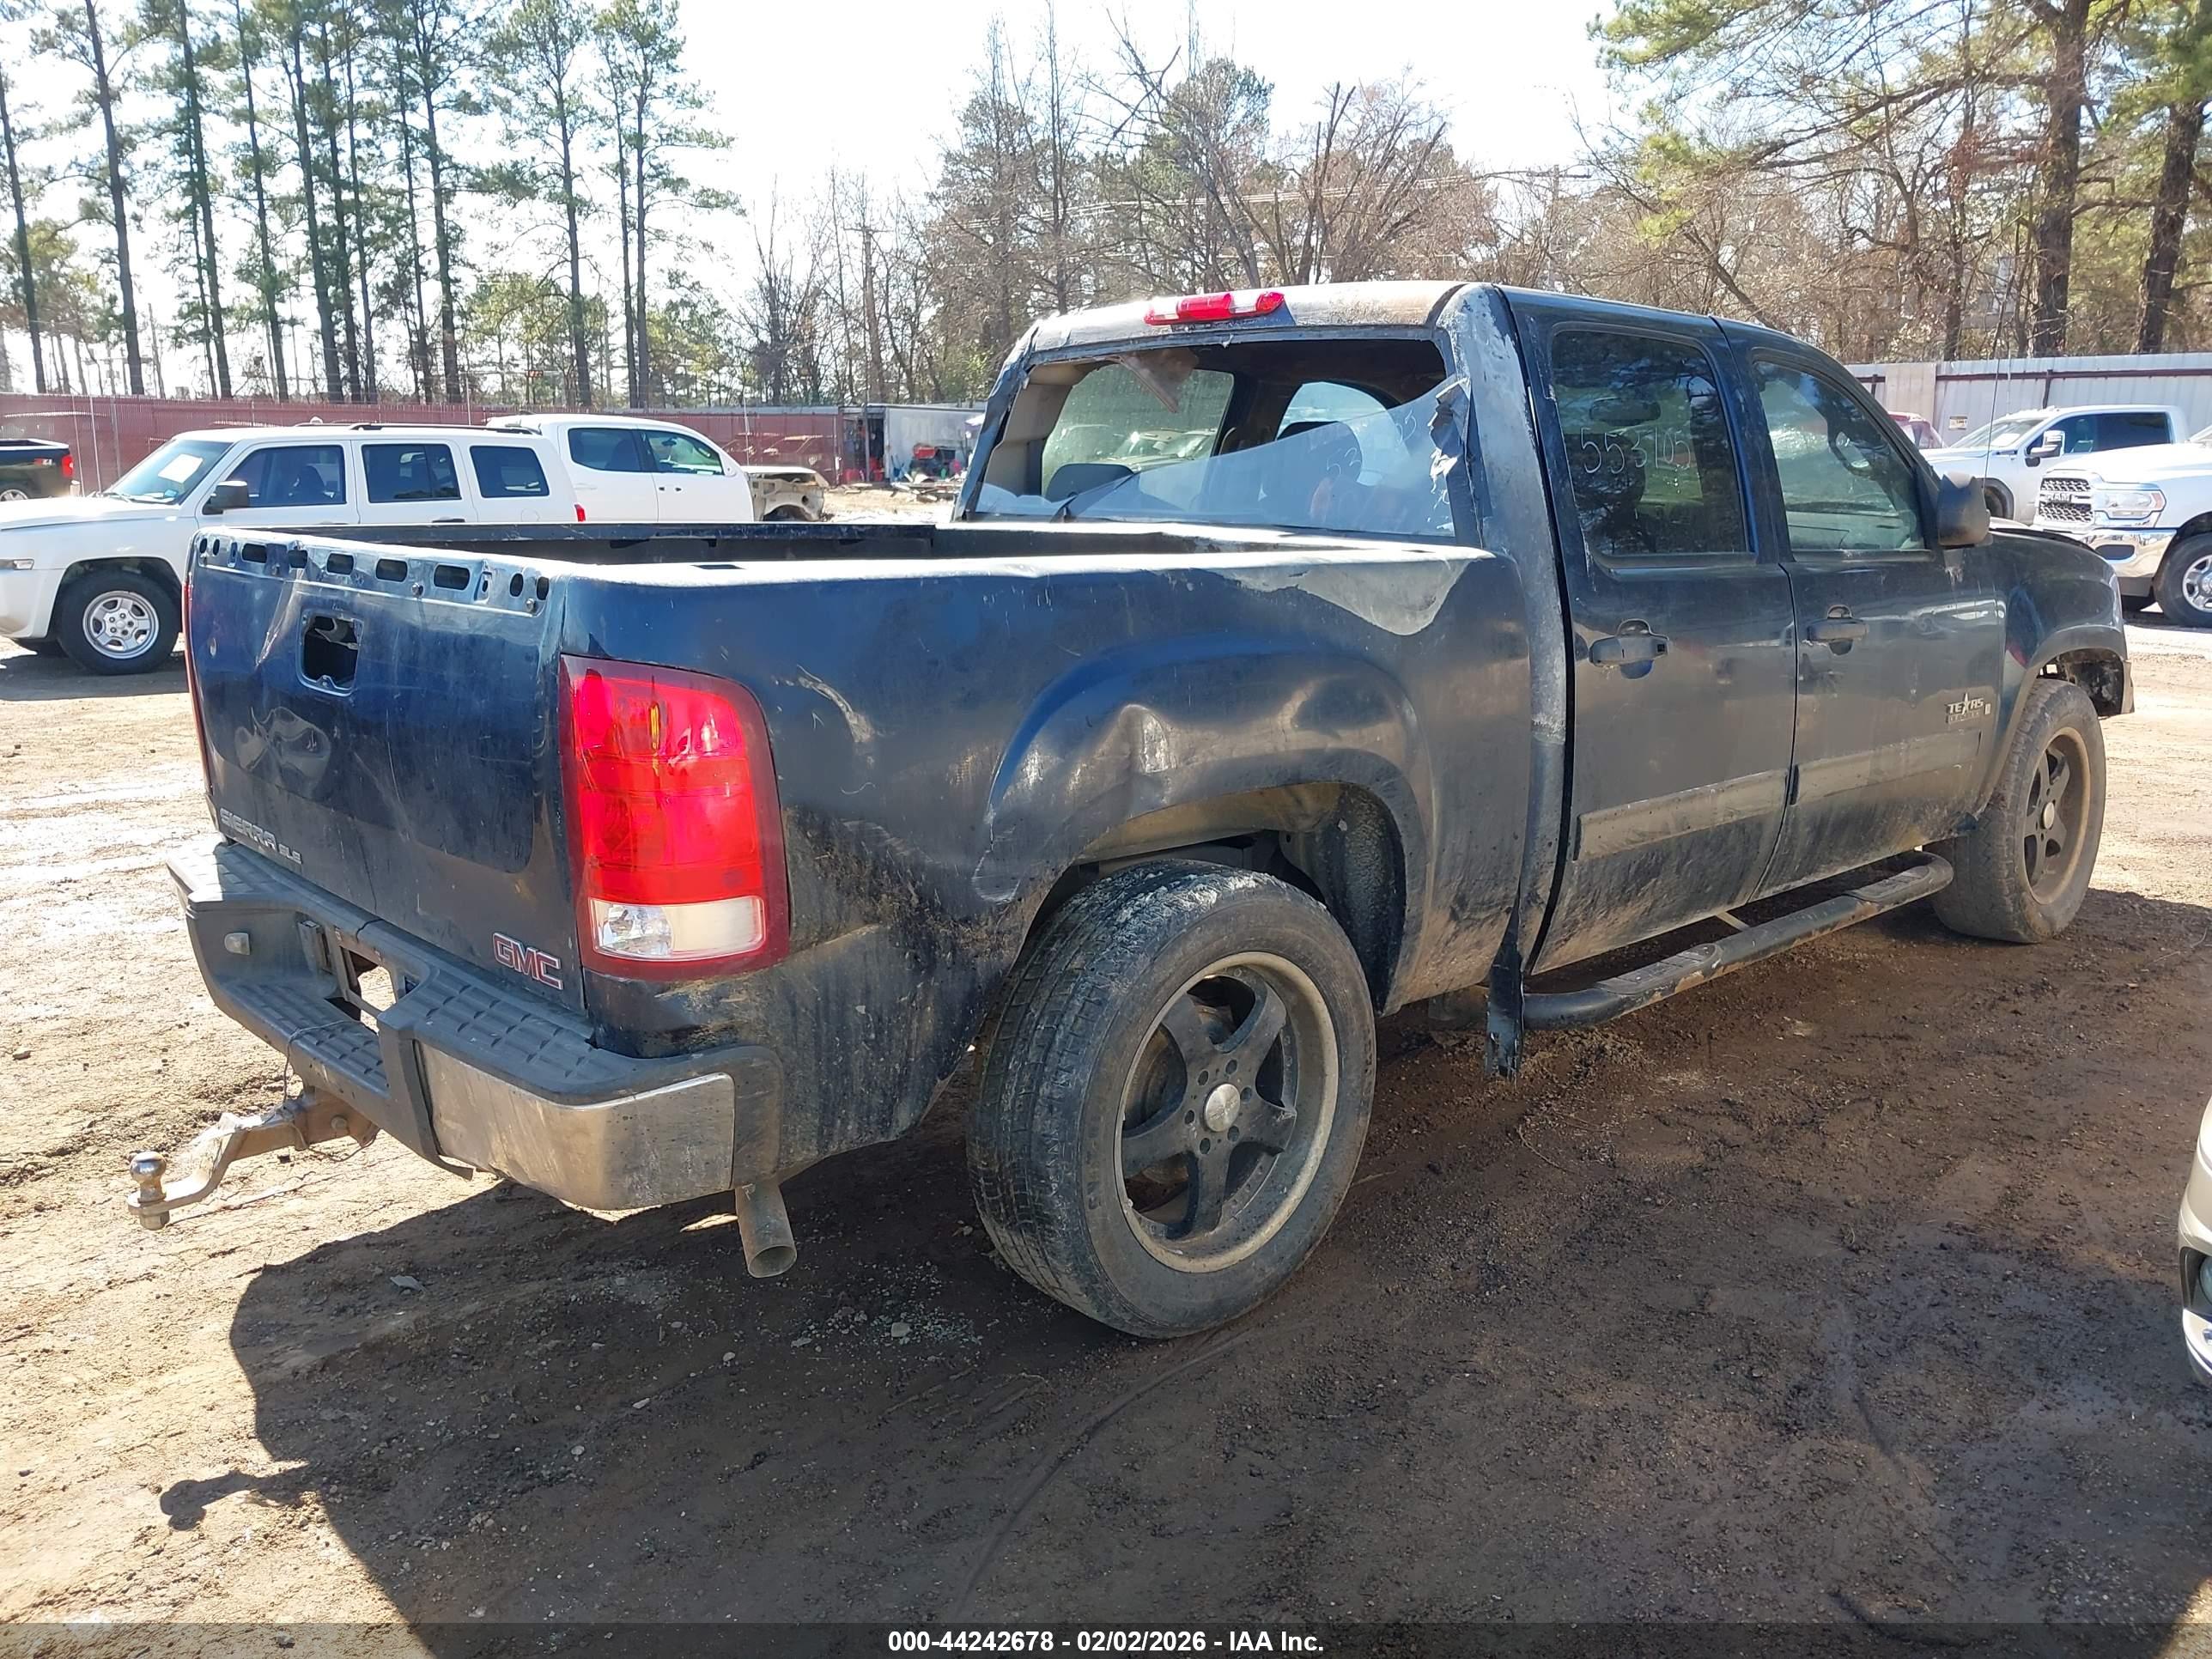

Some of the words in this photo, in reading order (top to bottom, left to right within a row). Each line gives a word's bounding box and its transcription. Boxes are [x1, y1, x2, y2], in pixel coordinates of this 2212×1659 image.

[1579, 427, 1691, 474] 553105
[1947, 692, 1984, 715] TEXAS
[220, 807, 277, 850] SIERRA
[492, 932, 564, 990] GMC
